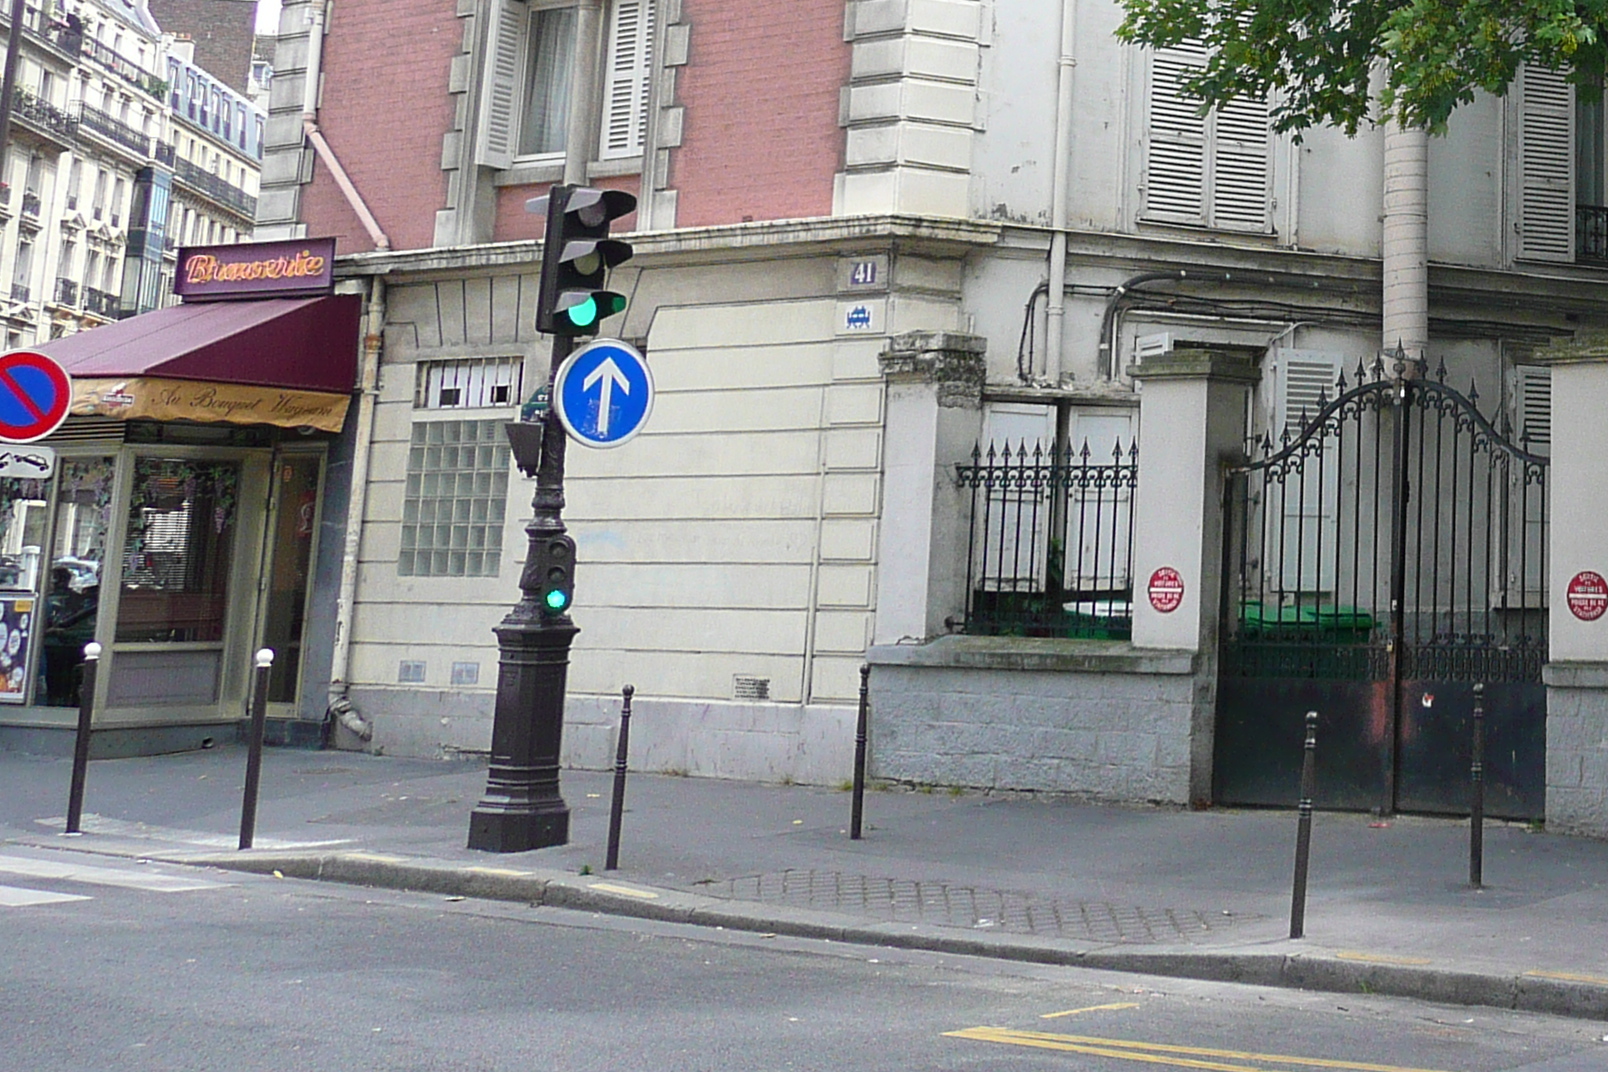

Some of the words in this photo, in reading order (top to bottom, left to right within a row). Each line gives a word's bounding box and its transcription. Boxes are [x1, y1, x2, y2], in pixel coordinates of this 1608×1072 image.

[855, 262, 873, 283] 41
[152, 385, 181, 406] Au
[190, 387, 264, 416] Bouquet
